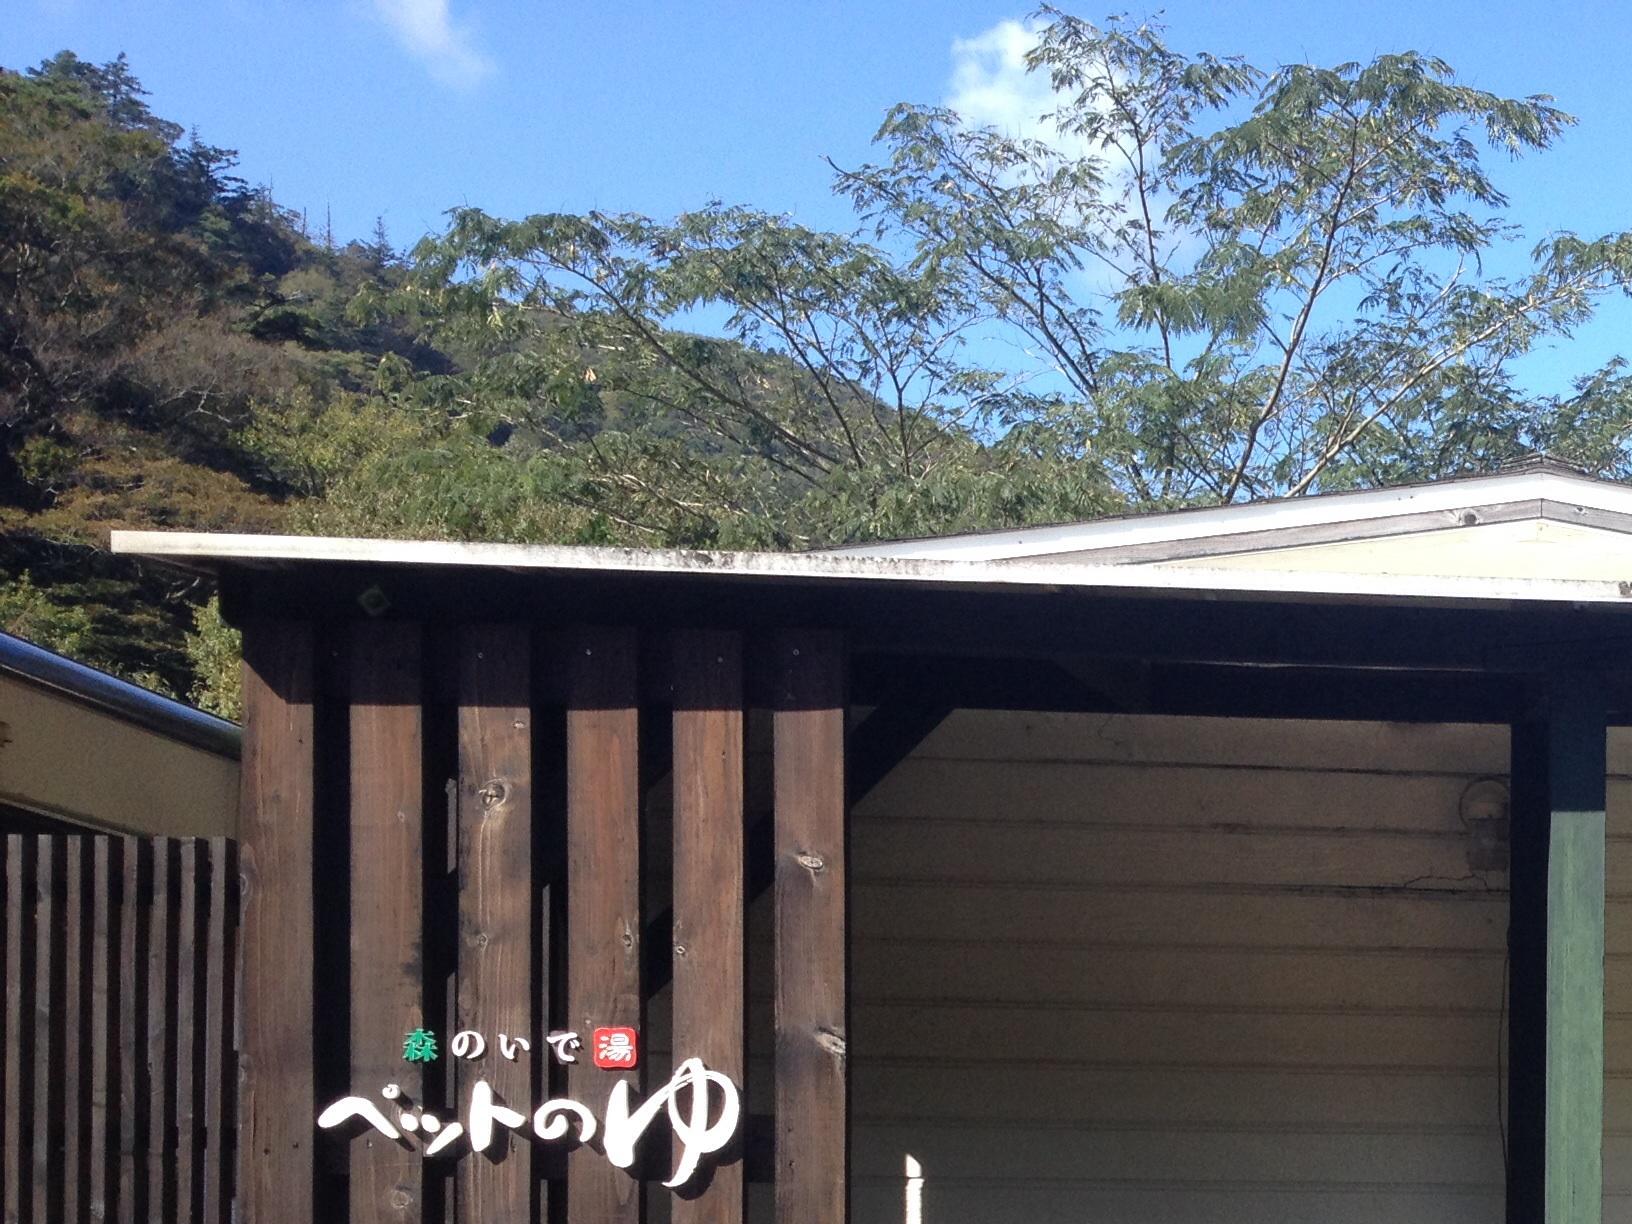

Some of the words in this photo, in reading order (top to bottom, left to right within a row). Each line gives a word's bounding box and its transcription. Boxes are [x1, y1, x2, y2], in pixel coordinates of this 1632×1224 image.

[402, 1027, 636, 1064] 森のいで湯
[317, 1057, 740, 1188] ペットのゆ
